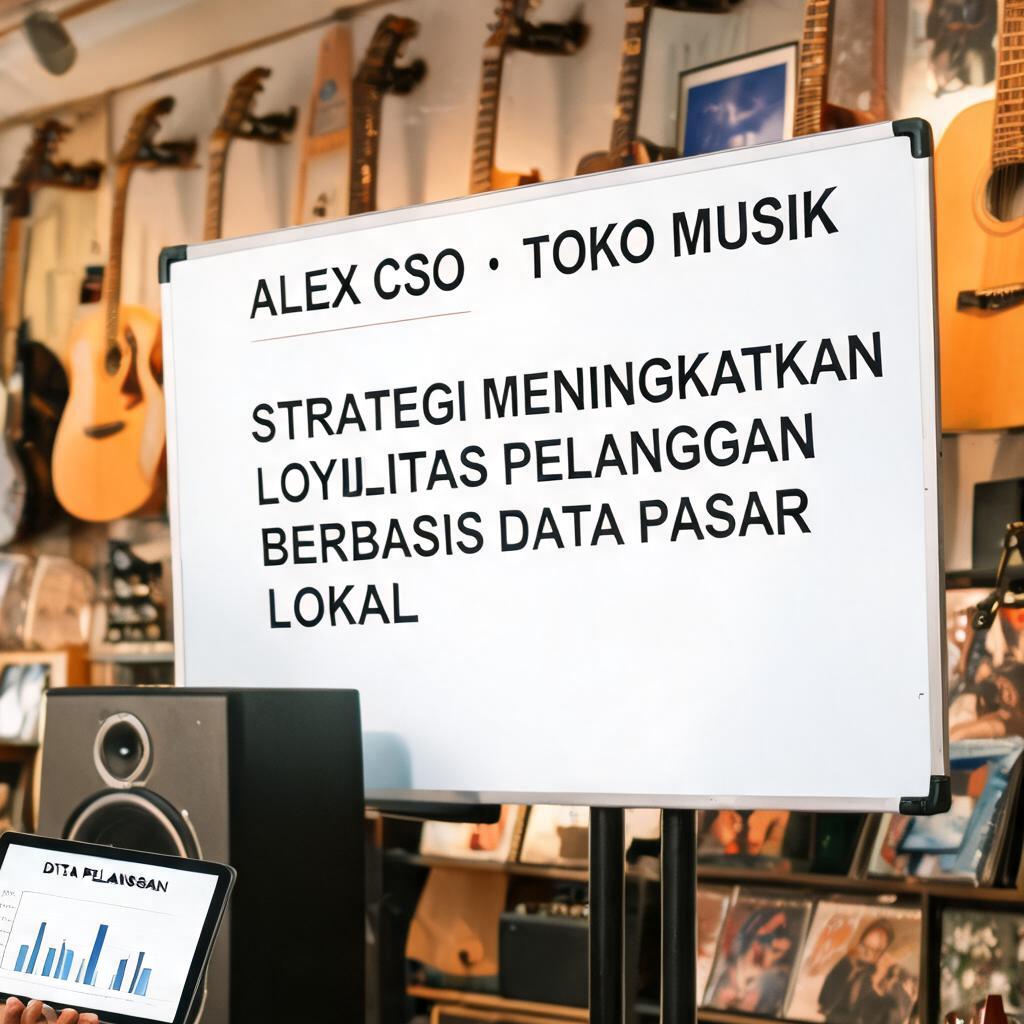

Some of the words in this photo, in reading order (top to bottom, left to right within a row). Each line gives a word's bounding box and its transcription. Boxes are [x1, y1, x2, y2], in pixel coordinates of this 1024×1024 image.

[250, 265, 362, 320] ALEX
[373, 247, 465, 301] CSO
[522, 218, 655, 281] TOKO
[672, 186, 839, 258] MUSIK
[251, 380, 466, 443] STRATEGI
[483, 331, 883, 420] MENINGKATKAN
[503, 412, 816, 486] PELANGGAN
[261, 511, 484, 567] BERBASIS
[499, 503, 625, 552] DATA
[639, 488, 812, 544] PASAR
[268, 582, 419, 629] LOKAL
